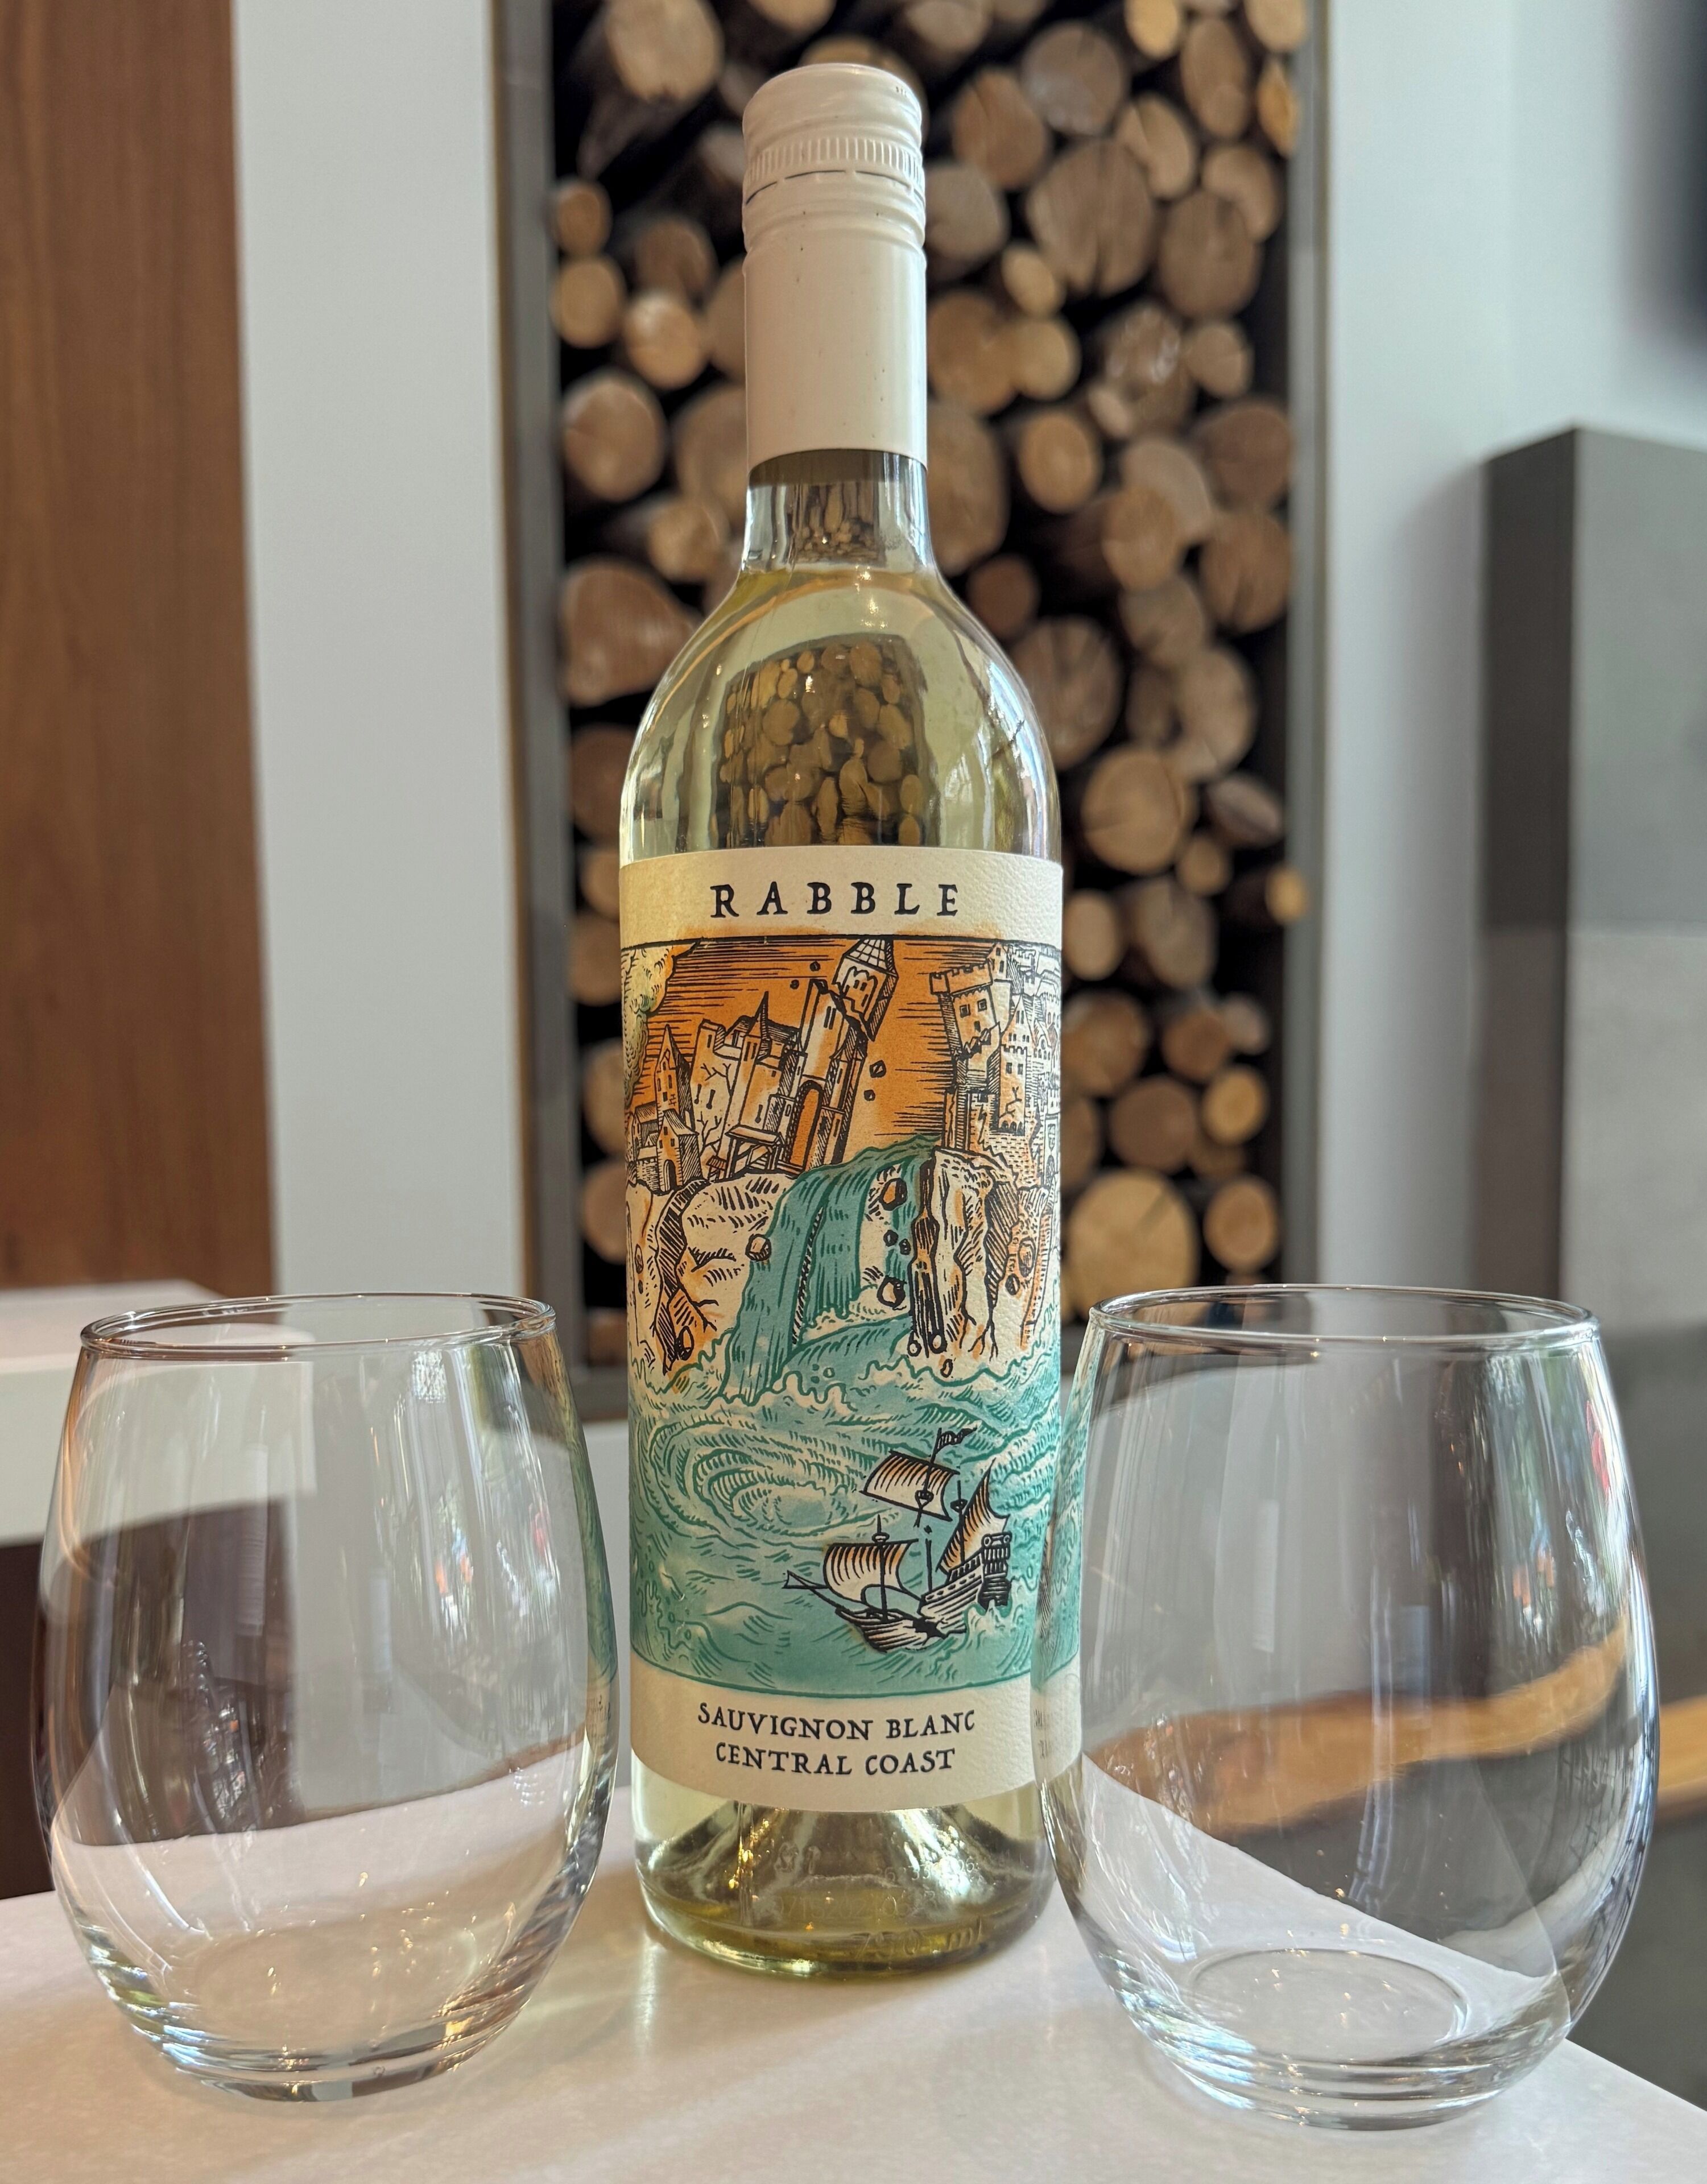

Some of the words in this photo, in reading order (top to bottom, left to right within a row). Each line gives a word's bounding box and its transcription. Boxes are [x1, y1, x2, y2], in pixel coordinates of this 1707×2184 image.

[710, 881, 958, 919] RABBLE
[697, 1702, 874, 1740] SAUVIGNON
[885, 1709, 976, 1739] BLANC
[716, 1742, 853, 1776] CENTRAL
[865, 1748, 956, 1776] COAST
